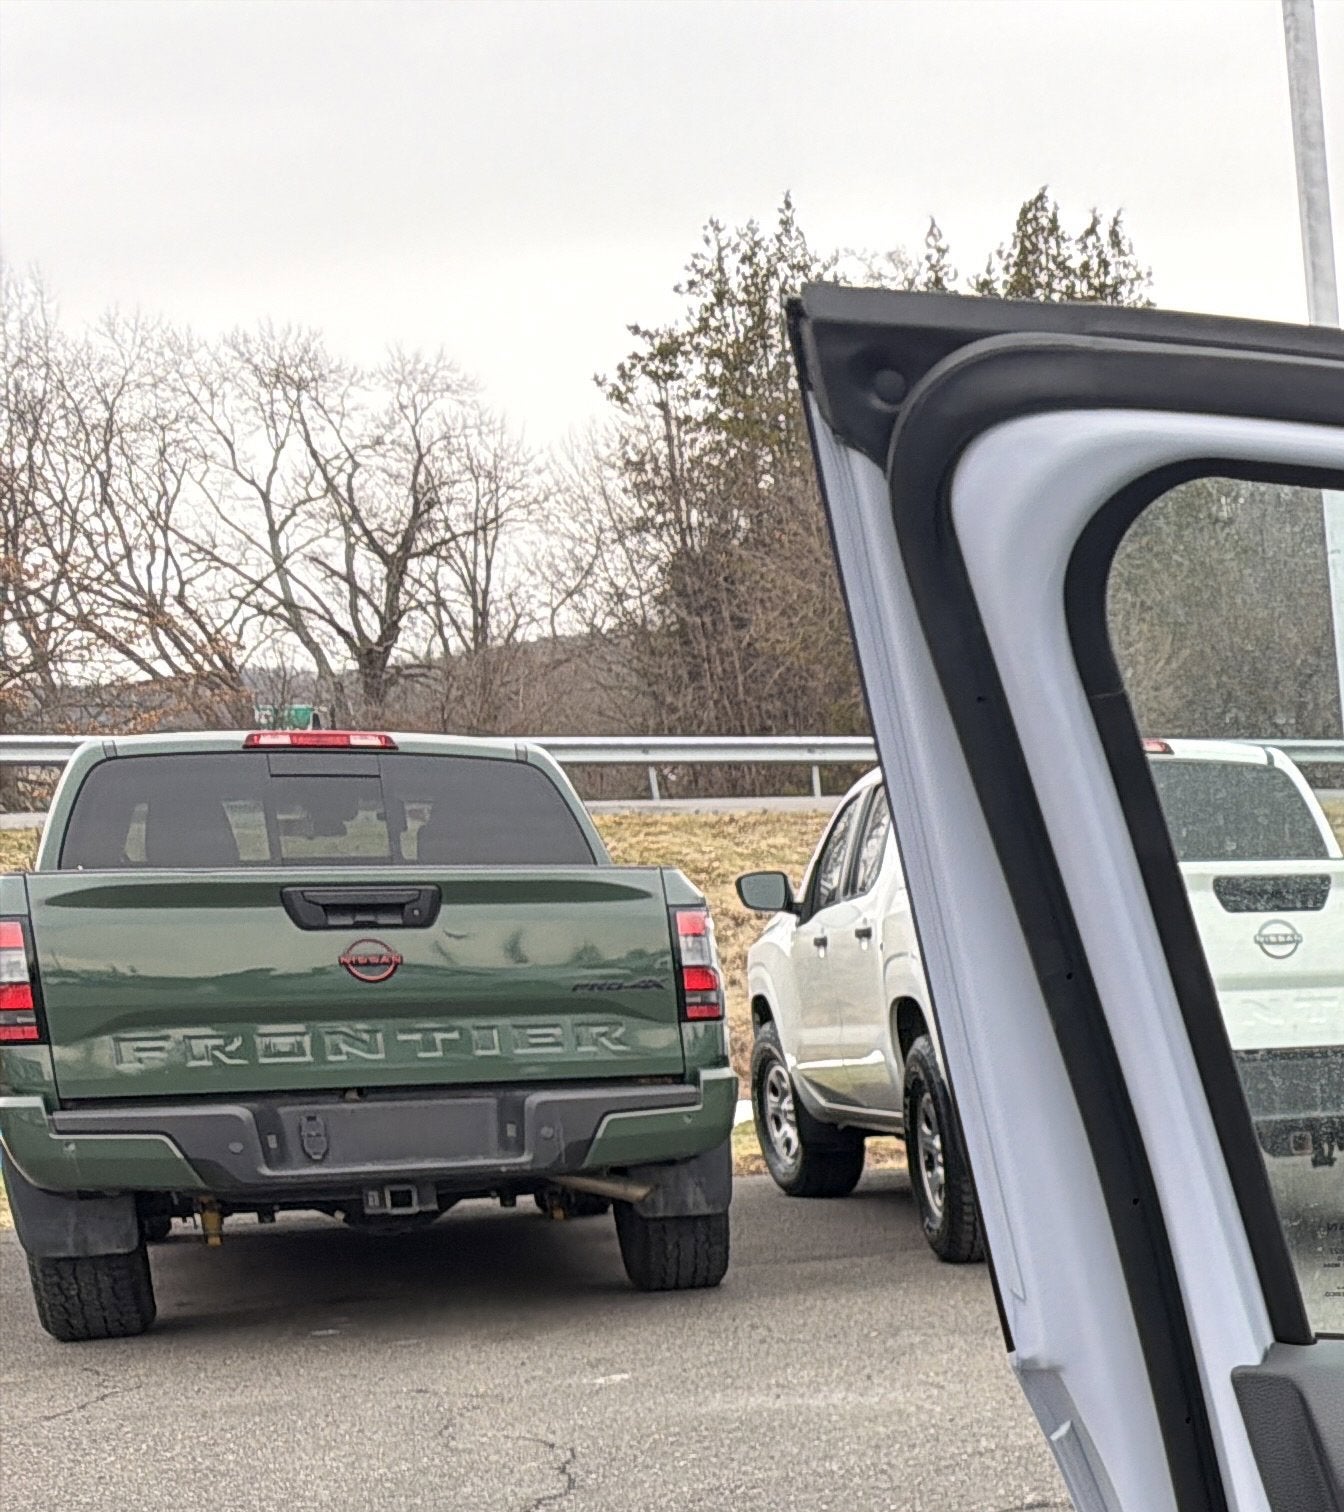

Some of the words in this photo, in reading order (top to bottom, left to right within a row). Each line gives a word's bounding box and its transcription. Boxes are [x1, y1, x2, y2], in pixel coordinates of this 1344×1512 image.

[1254, 933, 1303, 945] NISSAN
[338, 953, 404, 966] NISSAN
[110, 1020, 632, 1071] FRONTIER
